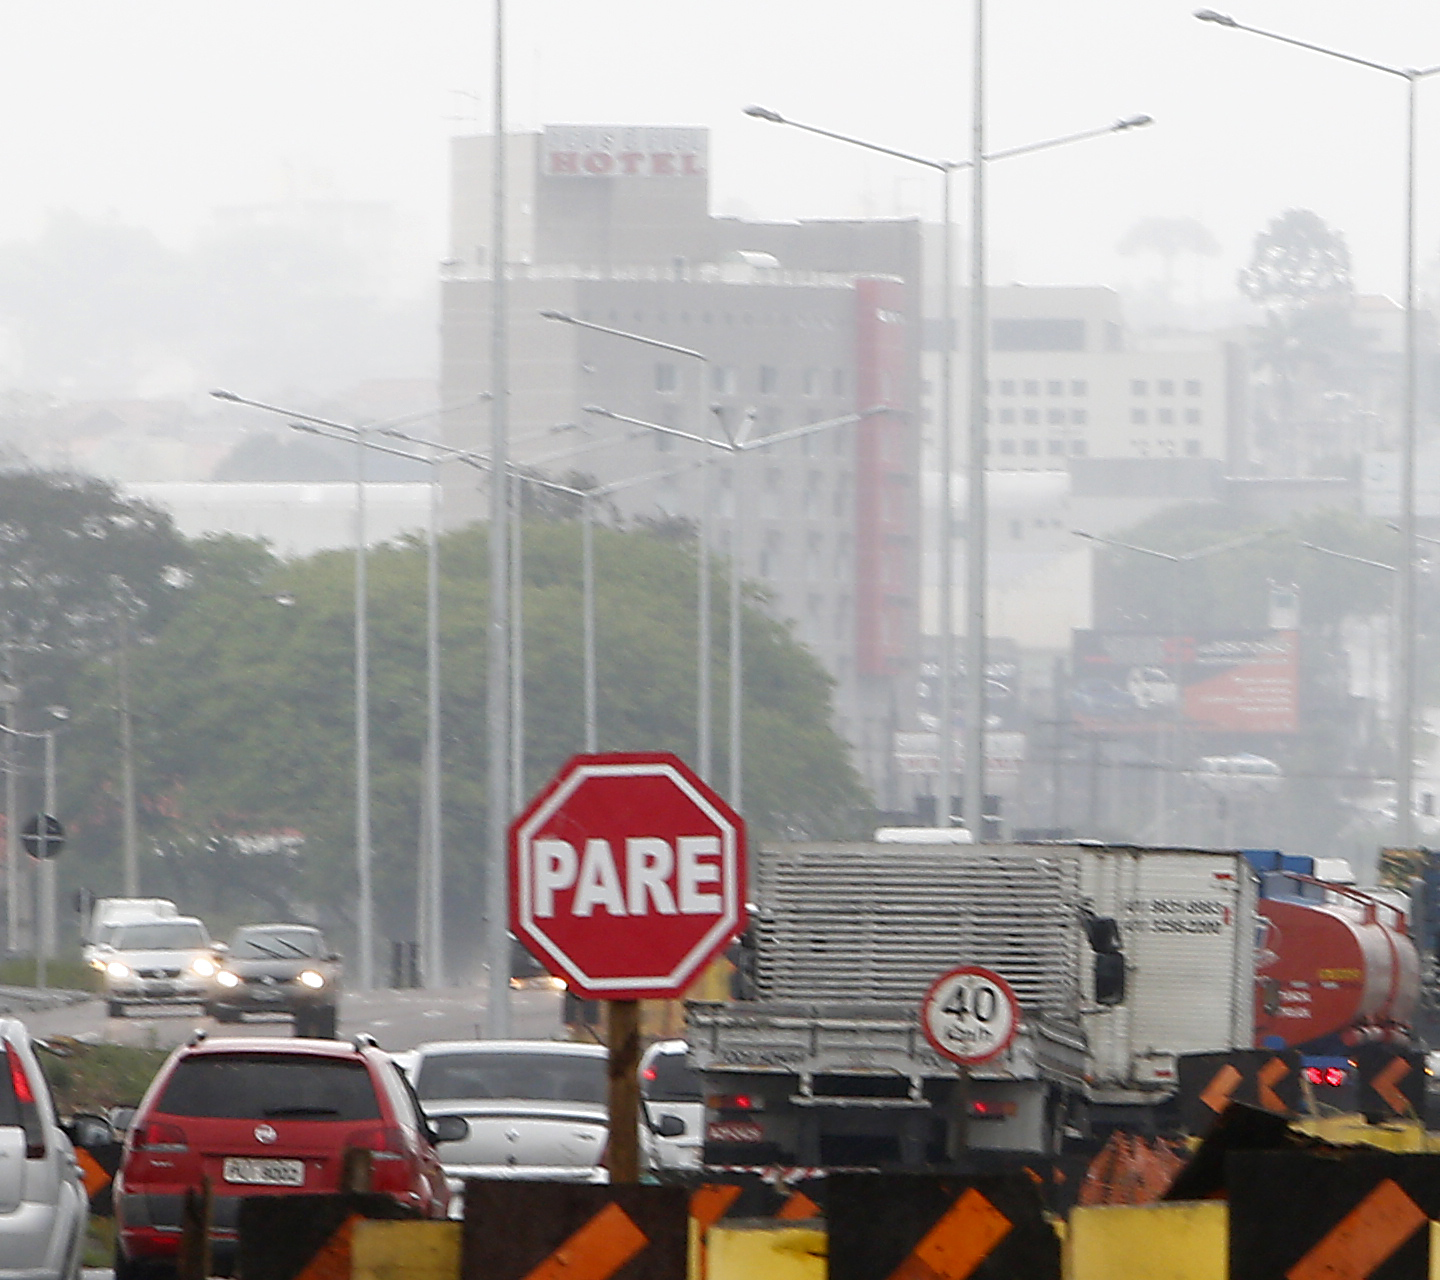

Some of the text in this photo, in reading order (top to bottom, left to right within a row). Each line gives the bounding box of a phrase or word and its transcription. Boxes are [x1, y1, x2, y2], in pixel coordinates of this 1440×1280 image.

[550, 151, 706, 175] HOTEL
[532, 836, 724, 918] PARE
[942, 986, 997, 1022] 40
